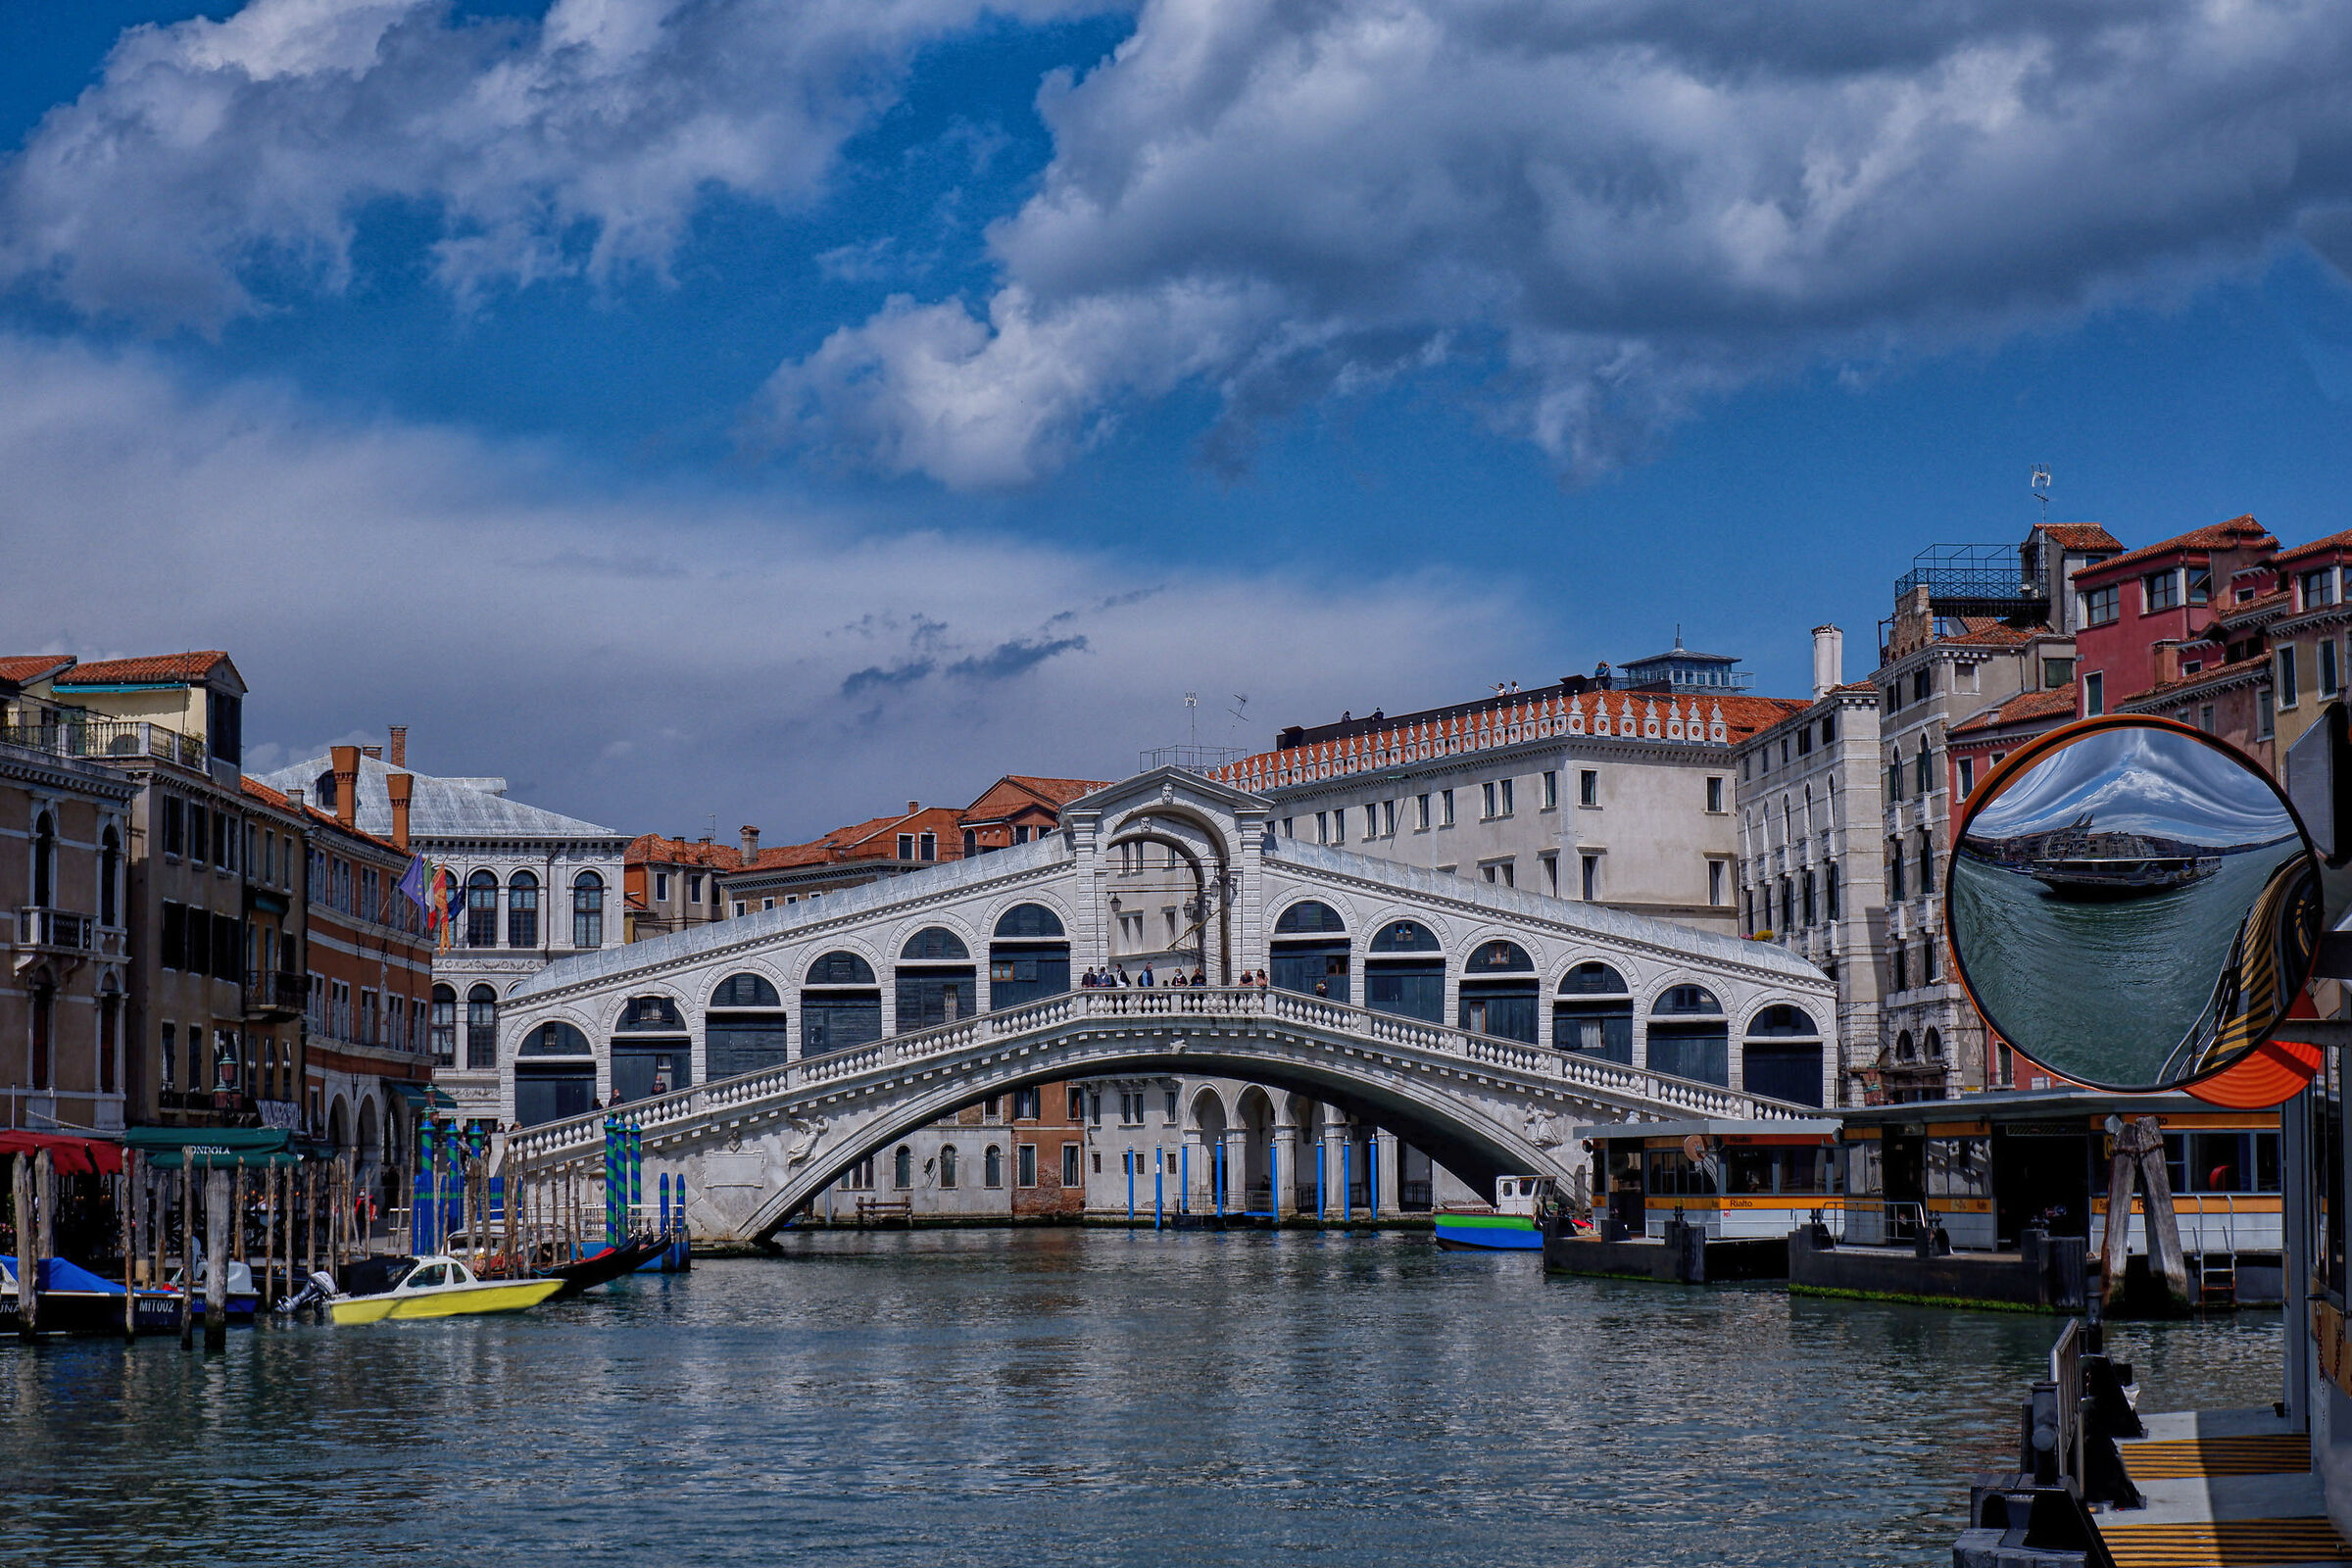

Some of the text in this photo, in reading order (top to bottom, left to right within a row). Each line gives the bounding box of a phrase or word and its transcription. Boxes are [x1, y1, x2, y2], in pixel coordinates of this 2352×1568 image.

[182, 1145, 230, 1154] ONDOLA
[1730, 1199, 1753, 1208] Rialto
[139, 1299, 174, 1313] MIT002
